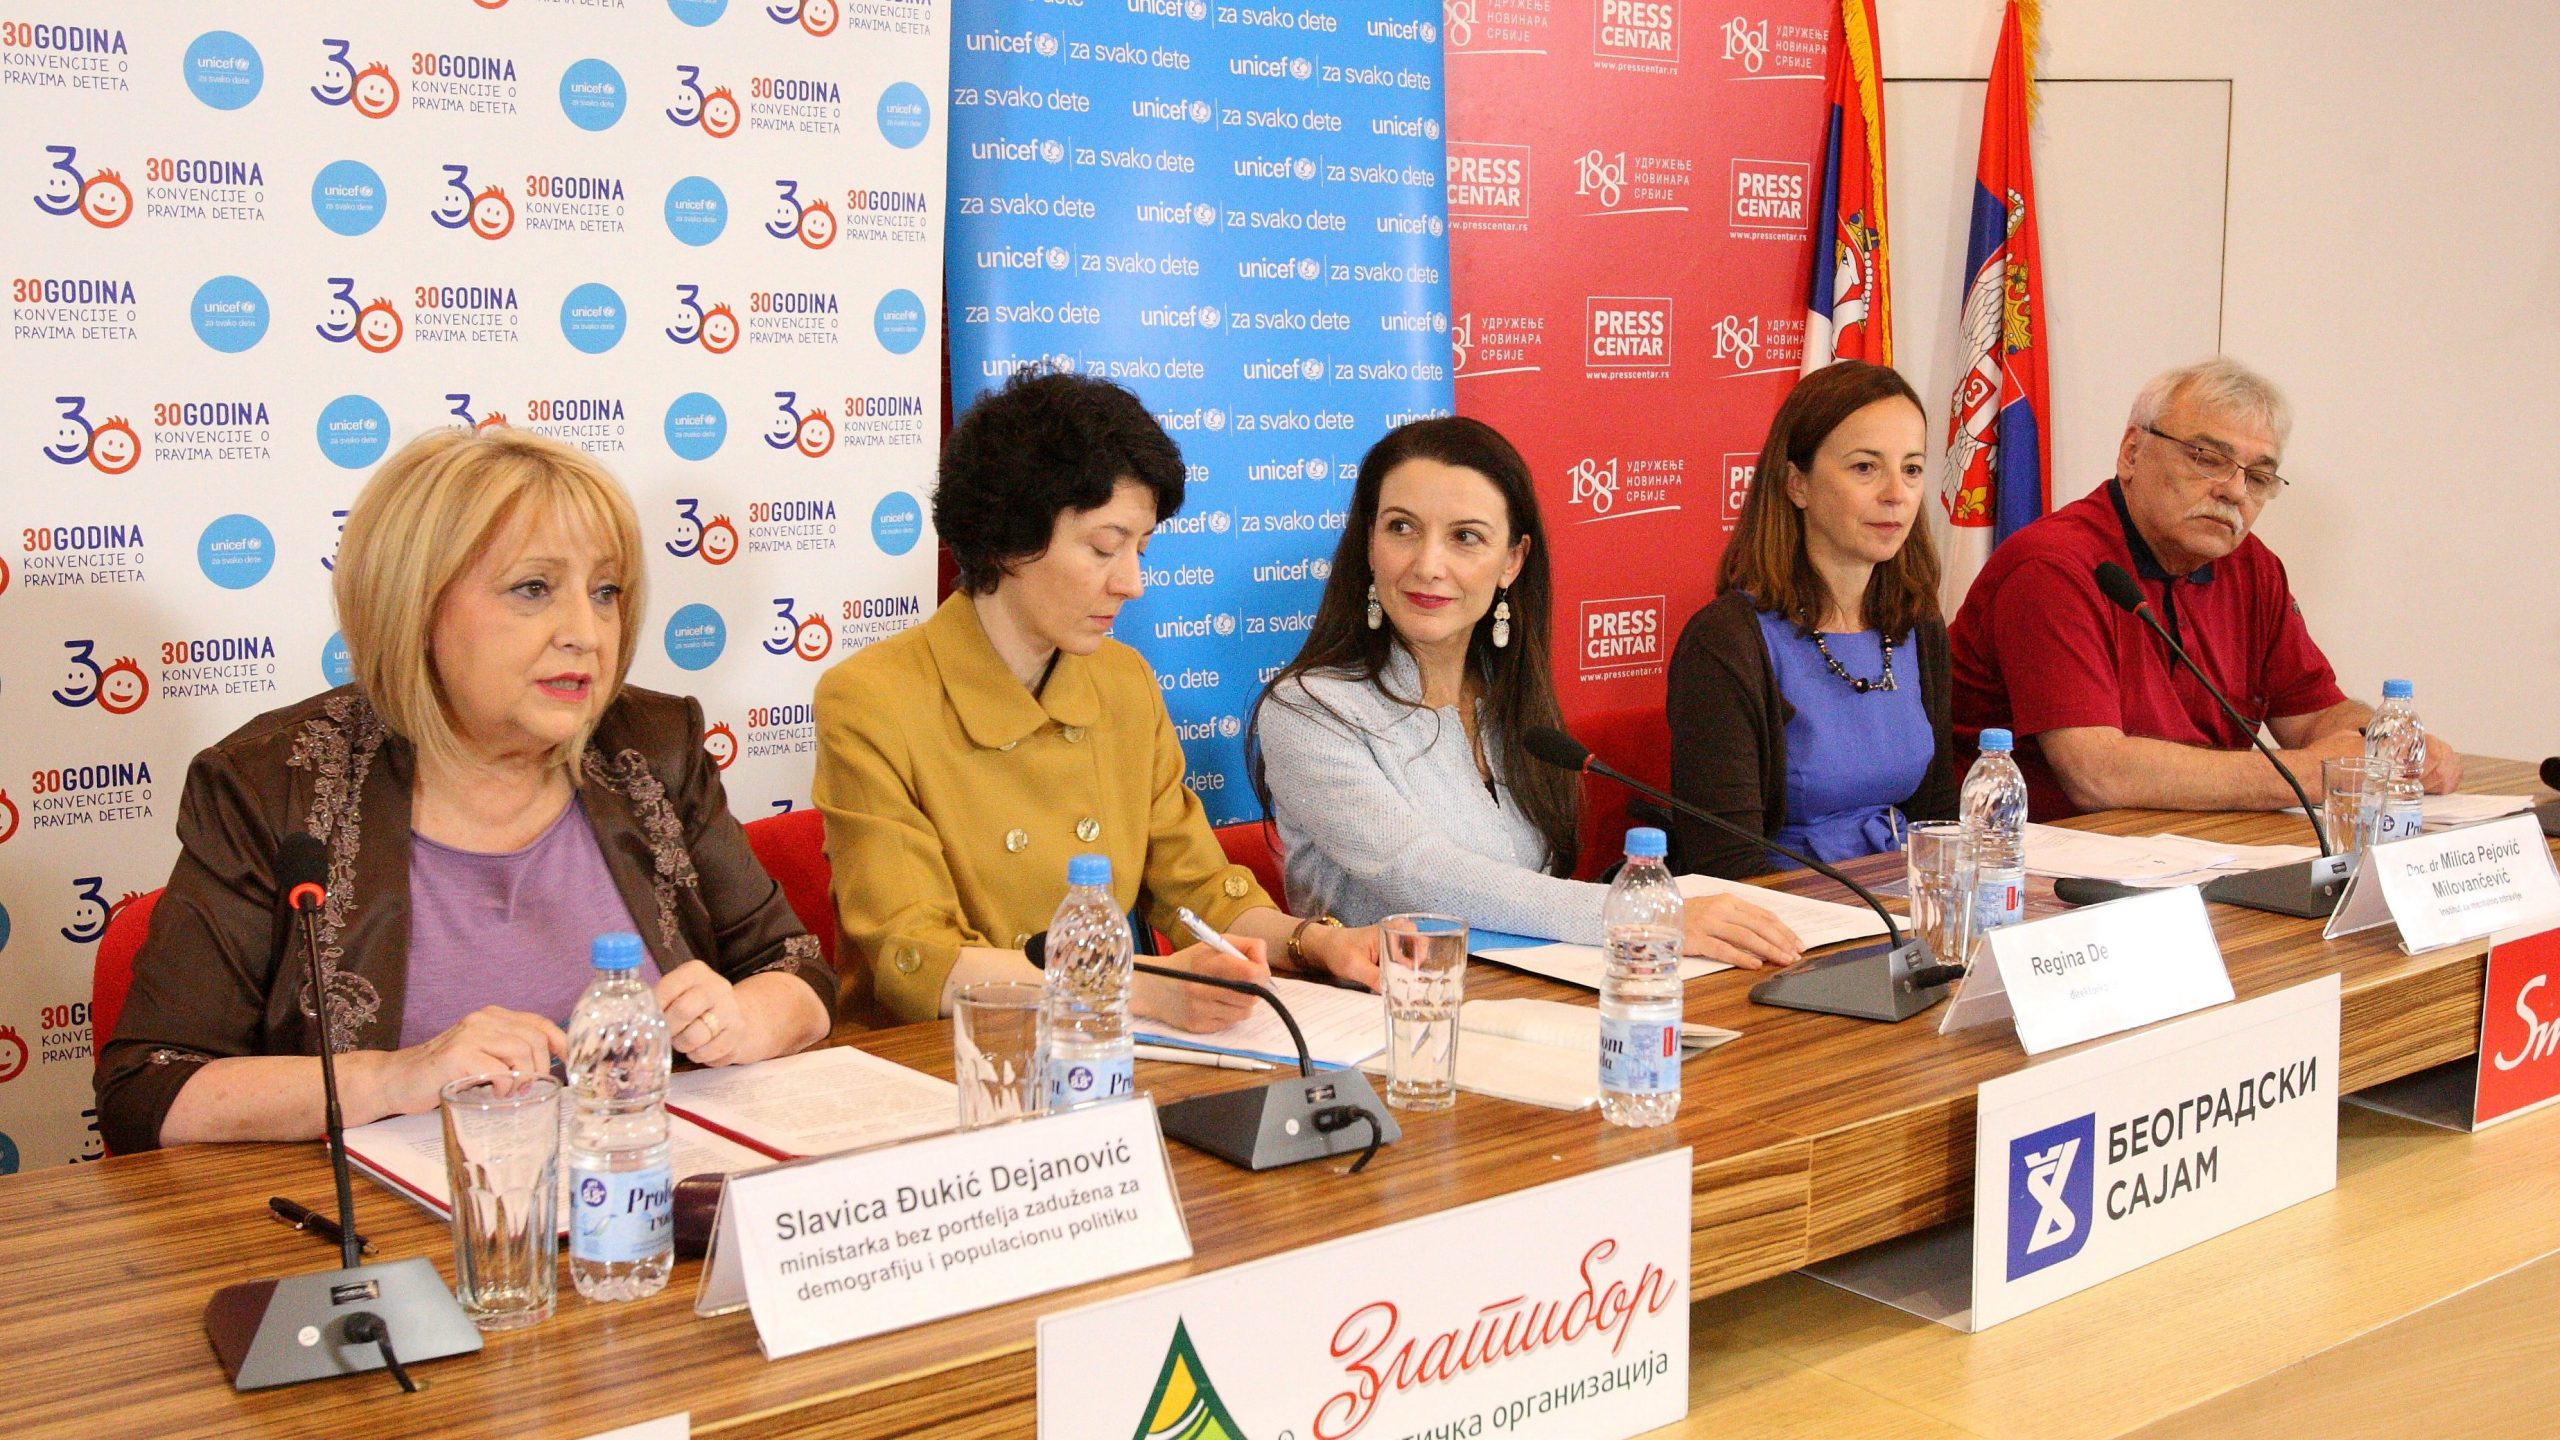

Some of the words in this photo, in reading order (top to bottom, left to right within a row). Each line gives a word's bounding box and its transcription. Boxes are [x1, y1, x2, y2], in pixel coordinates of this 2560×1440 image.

[849, 3, 918, 19] KONVENCIJE
[925, 10, 931, 20] O
[1218, 7, 1237, 23] za
[1242, 6, 1294, 28] svako
[1298, 10, 1337, 32] dete
[1487, 12, 1548, 27] НОВИНАРА
[1603, 0, 1672, 29] PRESS
[849, 17, 891, 31] PRAVIMA
[895, 22, 930, 35] DETETA
[1487, 27, 1529, 42] СРБИЈЕ
[1775, 26, 1829, 41] УДРУЖЕЊЕ
[1602, 26, 1671, 50] CENTAR
[1720, 16, 1769, 72] 1881
[1775, 40, 1827, 55] НОВИНАРА
[967, 30, 1032, 53] unicef
[1070, 43, 1090, 59] za
[1095, 42, 1148, 65] svako
[1151, 46, 1190, 70] dete
[4, 53, 109, 72] KONVENCIJE
[118, 61, 128, 72] O
[198, 57, 238, 69] unicef
[1594, 61, 1677, 75] www.presscentar.rs
[1775, 55, 1811, 68] СРБИЈЕ
[4, 70, 66, 87] PRAVIMA
[73, 75, 128, 91] DETETA
[1230, 55, 1287, 77] unicef
[1322, 66, 1341, 82] za
[1345, 65, 1394, 86] svako
[1397, 68, 1430, 90] dete
[571, 82, 604, 93] unicef
[955, 89, 978, 105] za
[985, 85, 1043, 108] svako
[1047, 89, 1089, 112] dete
[751, 103, 826, 118] KONVENCIJE
[833, 108, 840, 118] O
[751, 118, 795, 131] PRAVIMA
[800, 121, 840, 133] DETETA
[1373, 115, 1422, 137] unicef
[1446, 156, 1520, 185] PRESS
[1635, 157, 1691, 172] УДРУЖЕЊЕ
[1574, 150, 1627, 207] 1881
[1635, 173, 1689, 185] НОВИНАРА
[1739, 173, 1801, 199] PRESS
[147, 188, 246, 203] KONVENCIJE
[255, 192, 264, 203] O
[324, 185, 361, 196] unicef
[1447, 184, 1520, 207] CENTAR
[1634, 188, 1673, 200] СРБИЈЕ
[148, 204, 206, 218] PRAVIMA
[213, 207, 264, 221] DETETA
[675, 199, 708, 210] unicef
[1737, 198, 1801, 218] CENTAR
[1137, 201, 1192, 224] unicef
[1227, 211, 1246, 227] za
[1251, 208, 1302, 229] svako
[1306, 209, 1346, 231] dete
[1730, 232, 1807, 241] www.presscentar.rs
[977, 246, 1044, 269] unicef
[1082, 255, 1101, 271] za
[1106, 252, 1156, 274] svako
[1160, 254, 1199, 276] dete
[205, 301, 240, 312] unicef
[415, 314, 502, 326] KONVENCIJE
[510, 315, 518, 325] O
[1482, 318, 1543, 330] УДРУЖЕЊЕ
[1595, 311, 1663, 335] PRESS
[416, 329, 466, 341] PRAVIMA
[472, 330, 518, 342] DETETA
[1481, 333, 1541, 344] НОВИНАРА
[1711, 315, 1760, 369] 1881
[1481, 349, 1523, 360] СРБИЈЕ
[1594, 337, 1662, 356] CENTAR
[1766, 350, 1802, 360] СРБИЈЕ
[1244, 358, 1300, 379] unicef
[1335, 365, 1353, 379] za
[1359, 360, 1408, 380] svako
[1411, 363, 1442, 381] dete
[1586, 371, 1669, 380] www.presscentar.rs
[330, 419, 365, 430] unicef
[1236, 415, 1255, 430] za
[1260, 410, 1310, 430] svako
[1314, 410, 1354, 430] dete
[155, 430, 252, 443] KONVENCIJE
[261, 430, 269, 441] O
[155, 448, 212, 461] PRAVIMA
[219, 447, 270, 459] DETETA
[1249, 459, 1304, 480] unicef
[1627, 459, 1683, 473] УДРУЖЕЊЕ
[1567, 458, 1620, 513] 1881
[1627, 475, 1681, 486] НОВИНАРА
[1627, 490, 1665, 502] СРБИЈЕ
[1241, 516, 1260, 532] za
[1265, 510, 1314, 531] svako
[1319, 510, 1345, 529] det
[211, 538, 249, 551] unicef
[1254, 559, 1308, 582] unicef
[1155, 614, 1211, 638] unicef
[1589, 609, 1656, 637] PRESS
[1588, 635, 1655, 658] CENTAR
[162, 664, 257, 682] KONVENCIJE
[267, 663, 275, 674] O
[1179, 668, 1219, 689] dete
[1580, 667, 1662, 682] www.presscentar.rs
[163, 684, 218, 699] PRAVIMA
[226, 680, 275, 693] DETETA
[2406, 864, 2428, 876] Doc.
[2430, 859, 2440, 872] dr
[2440, 850, 2475, 868] Milica
[2478, 839, 2520, 863] Pejović
[2432, 868, 2511, 898] Milovančević
[2031, 951, 2086, 976] Regina
[2087, 943, 2108, 962] De
[2109, 1057, 2316, 1167] БЕОГРАДСКИ
[776, 1199, 887, 1240] Slavica
[897, 1171, 981, 1213] Đukić
[990, 1138, 1130, 1195] Dejanović
[2107, 1142, 2217, 1220] САЈАМ
[780, 1237, 891, 1279] ministarka
[895, 1228, 932, 1247] bez
[938, 1206, 1019, 1242] portfelja
[1025, 1186, 1114, 1217] zadužena
[1119, 1180, 1139, 1195] za
[797, 1253, 923, 1301] demografiju
[928, 1253, 935, 1269] i
[938, 1222, 1063, 1271] populacionu
[1068, 1208, 1138, 1240] politiku
[1492, 1347, 1669, 1431] организација
